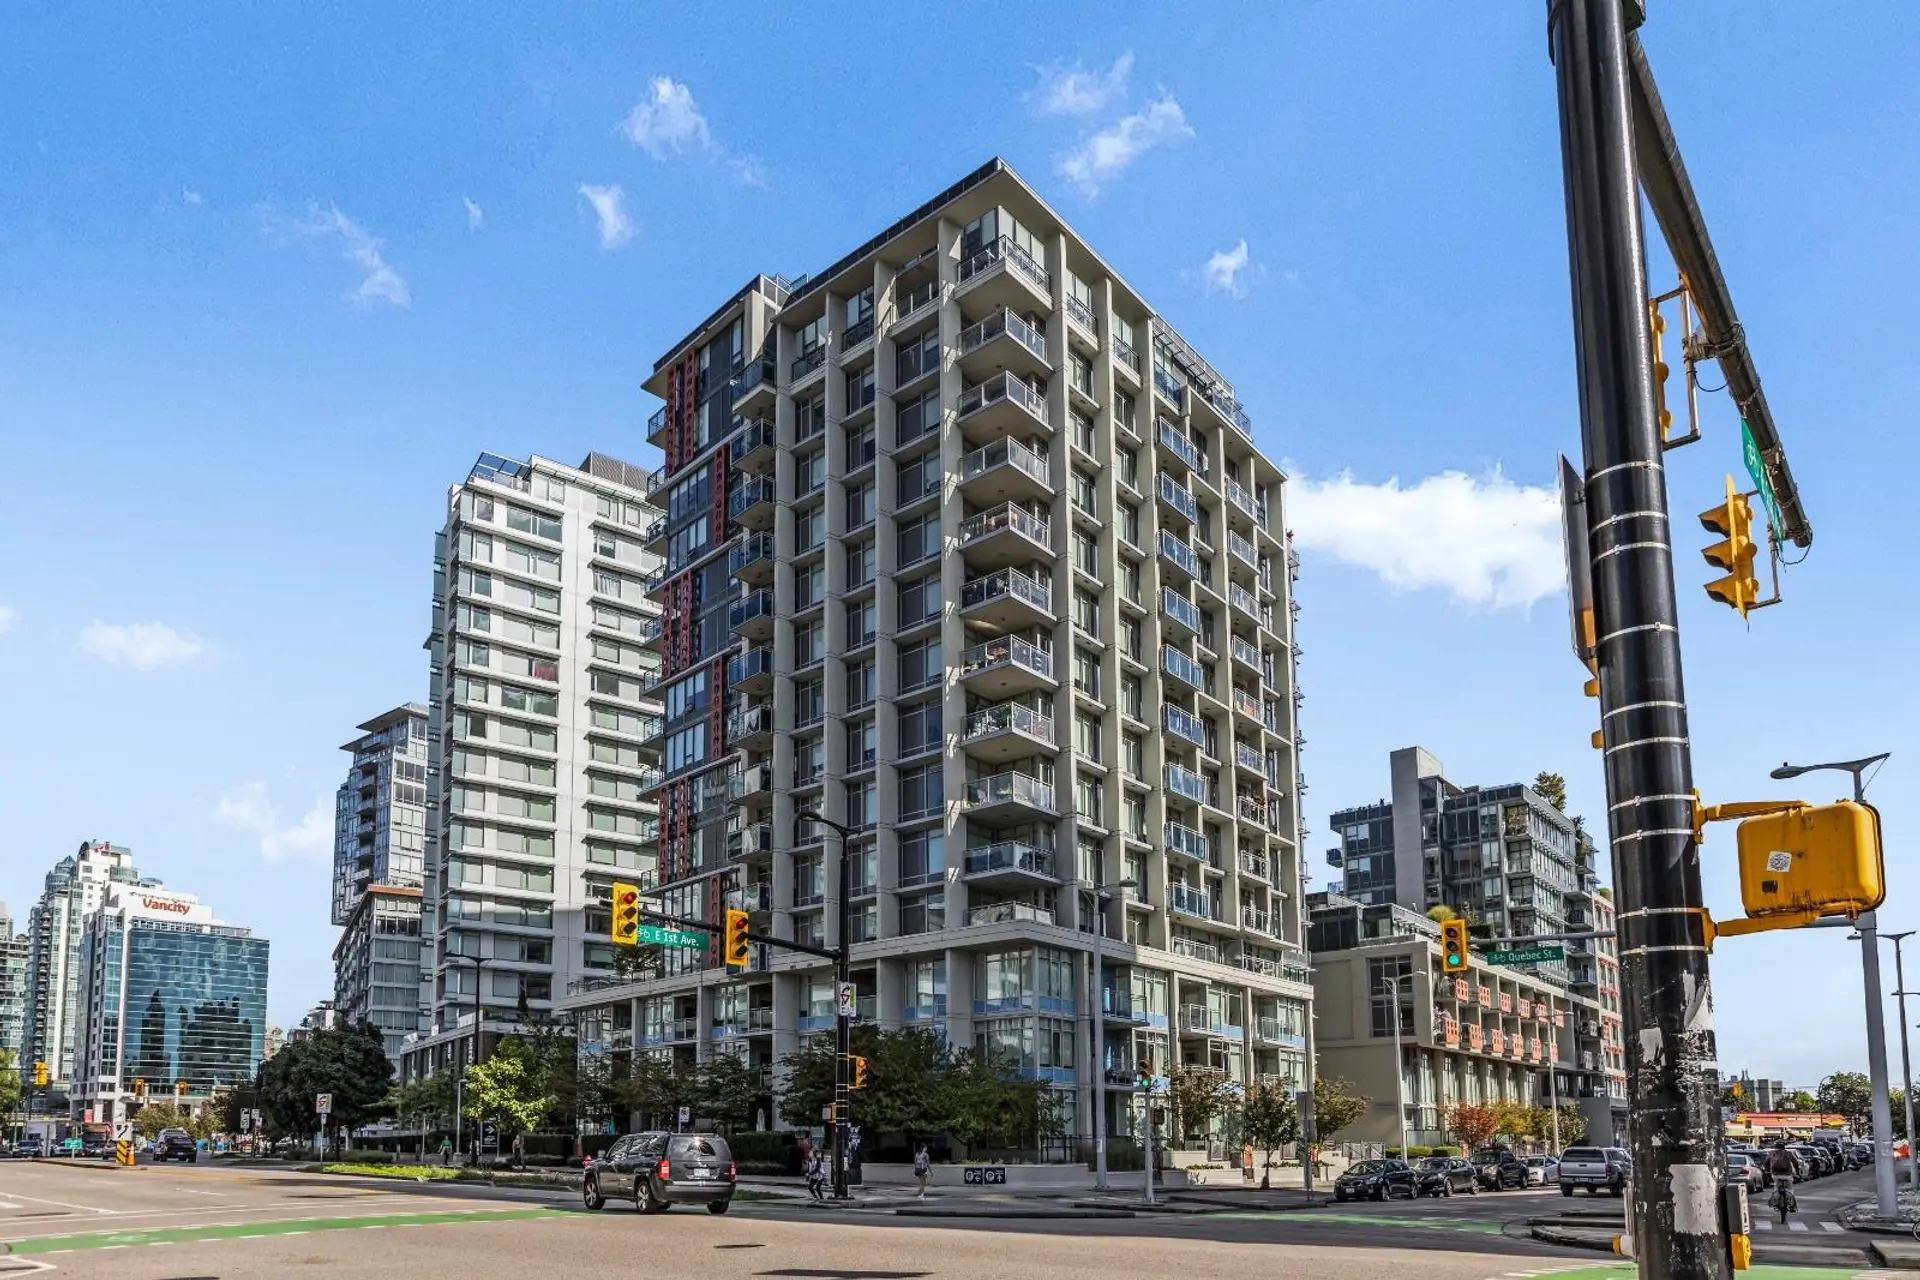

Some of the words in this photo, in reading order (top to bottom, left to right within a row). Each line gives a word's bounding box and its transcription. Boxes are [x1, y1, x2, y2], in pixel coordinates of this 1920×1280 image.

[142, 898, 191, 915] Vancity
[655, 931, 660, 941] E
[664, 932, 678, 944] 1st
[680, 935, 699, 947] Ave.
[1508, 951, 1541, 962] Quebec
[1543, 949, 1557, 959] St.
